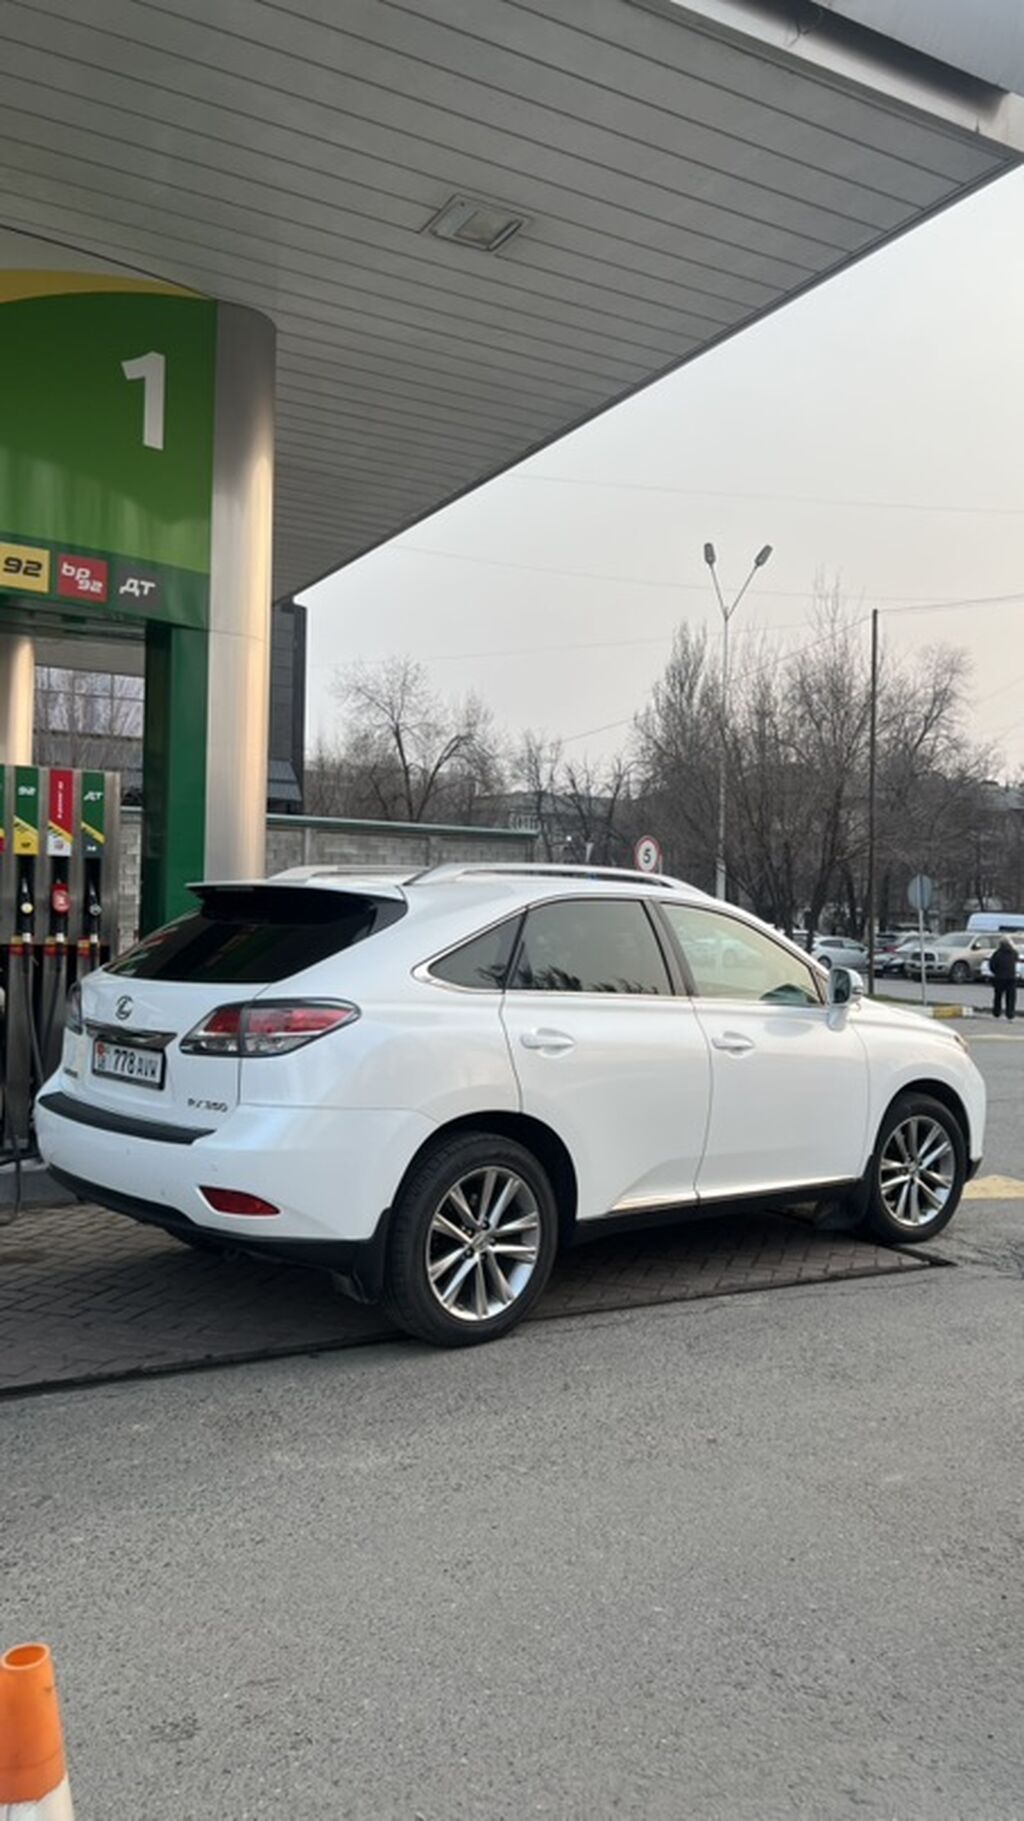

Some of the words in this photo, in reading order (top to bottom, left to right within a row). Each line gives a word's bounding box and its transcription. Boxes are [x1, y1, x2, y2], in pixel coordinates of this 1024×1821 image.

[121, 351, 165, 451] 1
[3, 556, 42, 578] 92
[77, 579, 103, 594] 92
[119, 577, 156, 597] ДТ
[642, 848, 651, 864] 5
